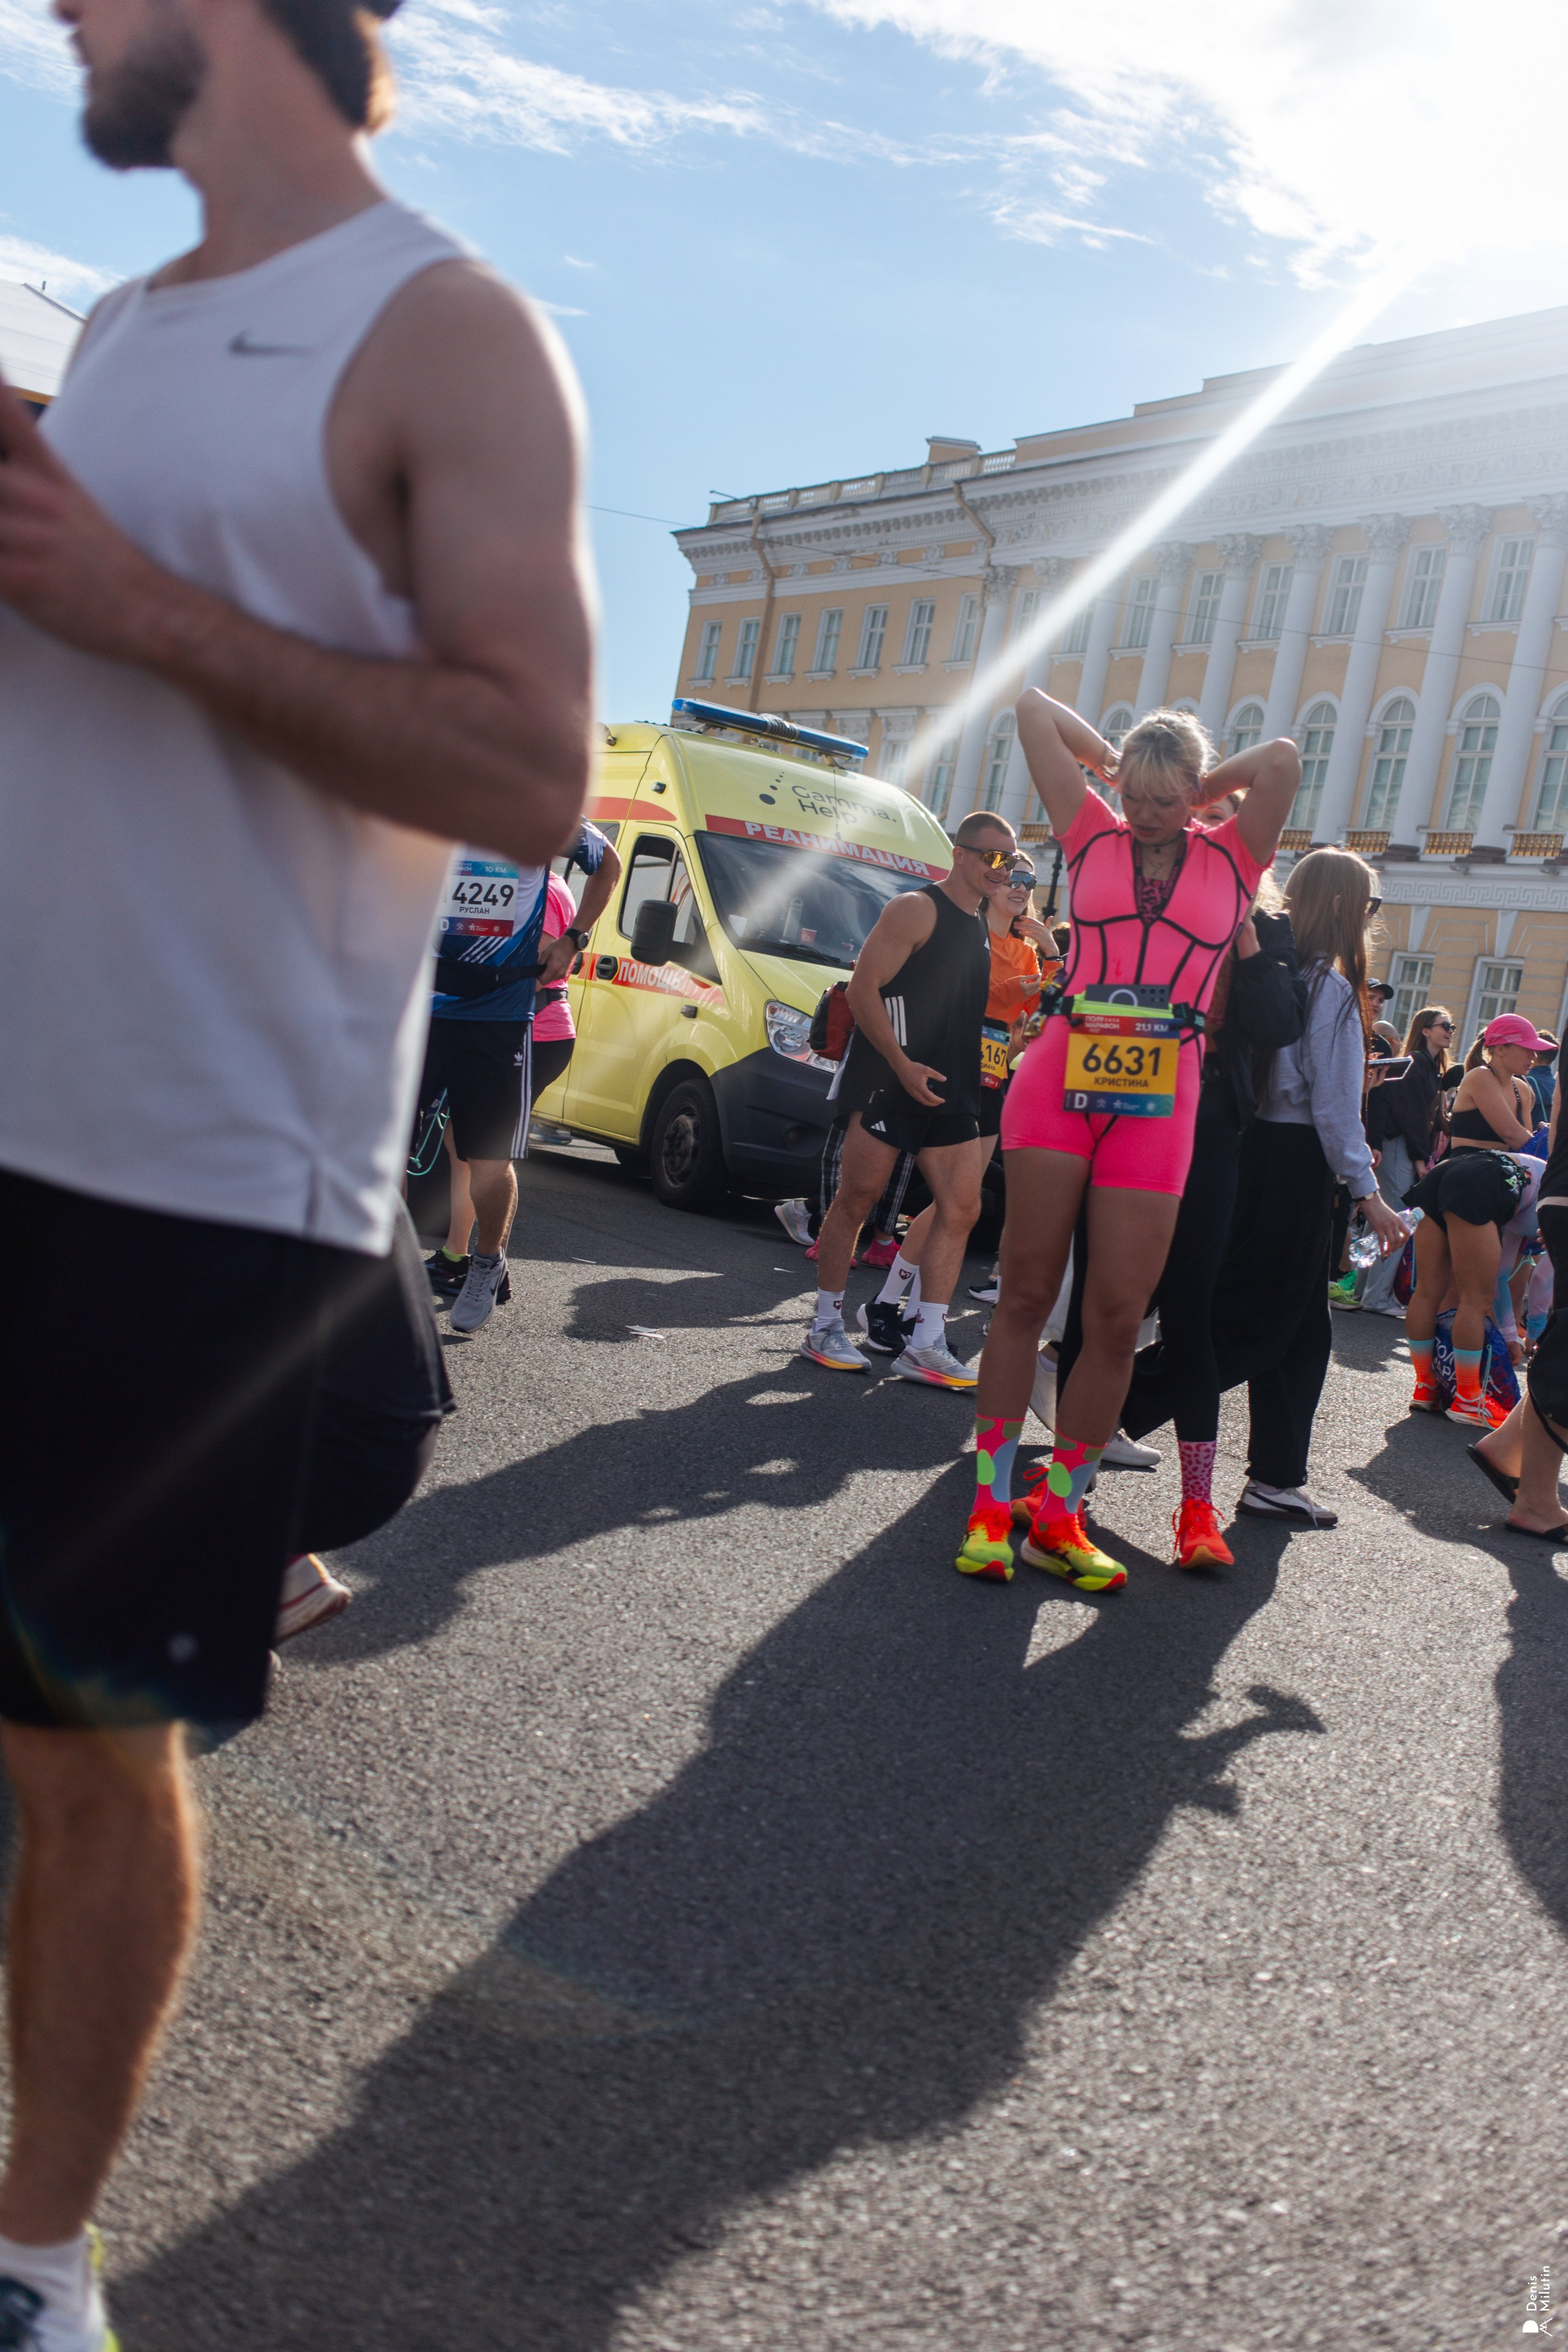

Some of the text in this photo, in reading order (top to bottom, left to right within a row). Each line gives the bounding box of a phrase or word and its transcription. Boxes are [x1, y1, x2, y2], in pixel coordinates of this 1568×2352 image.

[791, 785, 897, 823] Gamma.
[797, 799, 858, 825] Help
[744, 821, 930, 876] РЕАНИМАЦИЯ
[442, 882, 514, 907] 4249
[440, 919, 450, 931] D
[617, 961, 681, 993] ПОМОЩЬ
[1135, 1023, 1151, 1031] 21,1
[1082, 1043, 1161, 1076] 6631
[1094, 1077, 1149, 1088] КРИСТИНА
[1074, 1093, 1088, 1109] D
